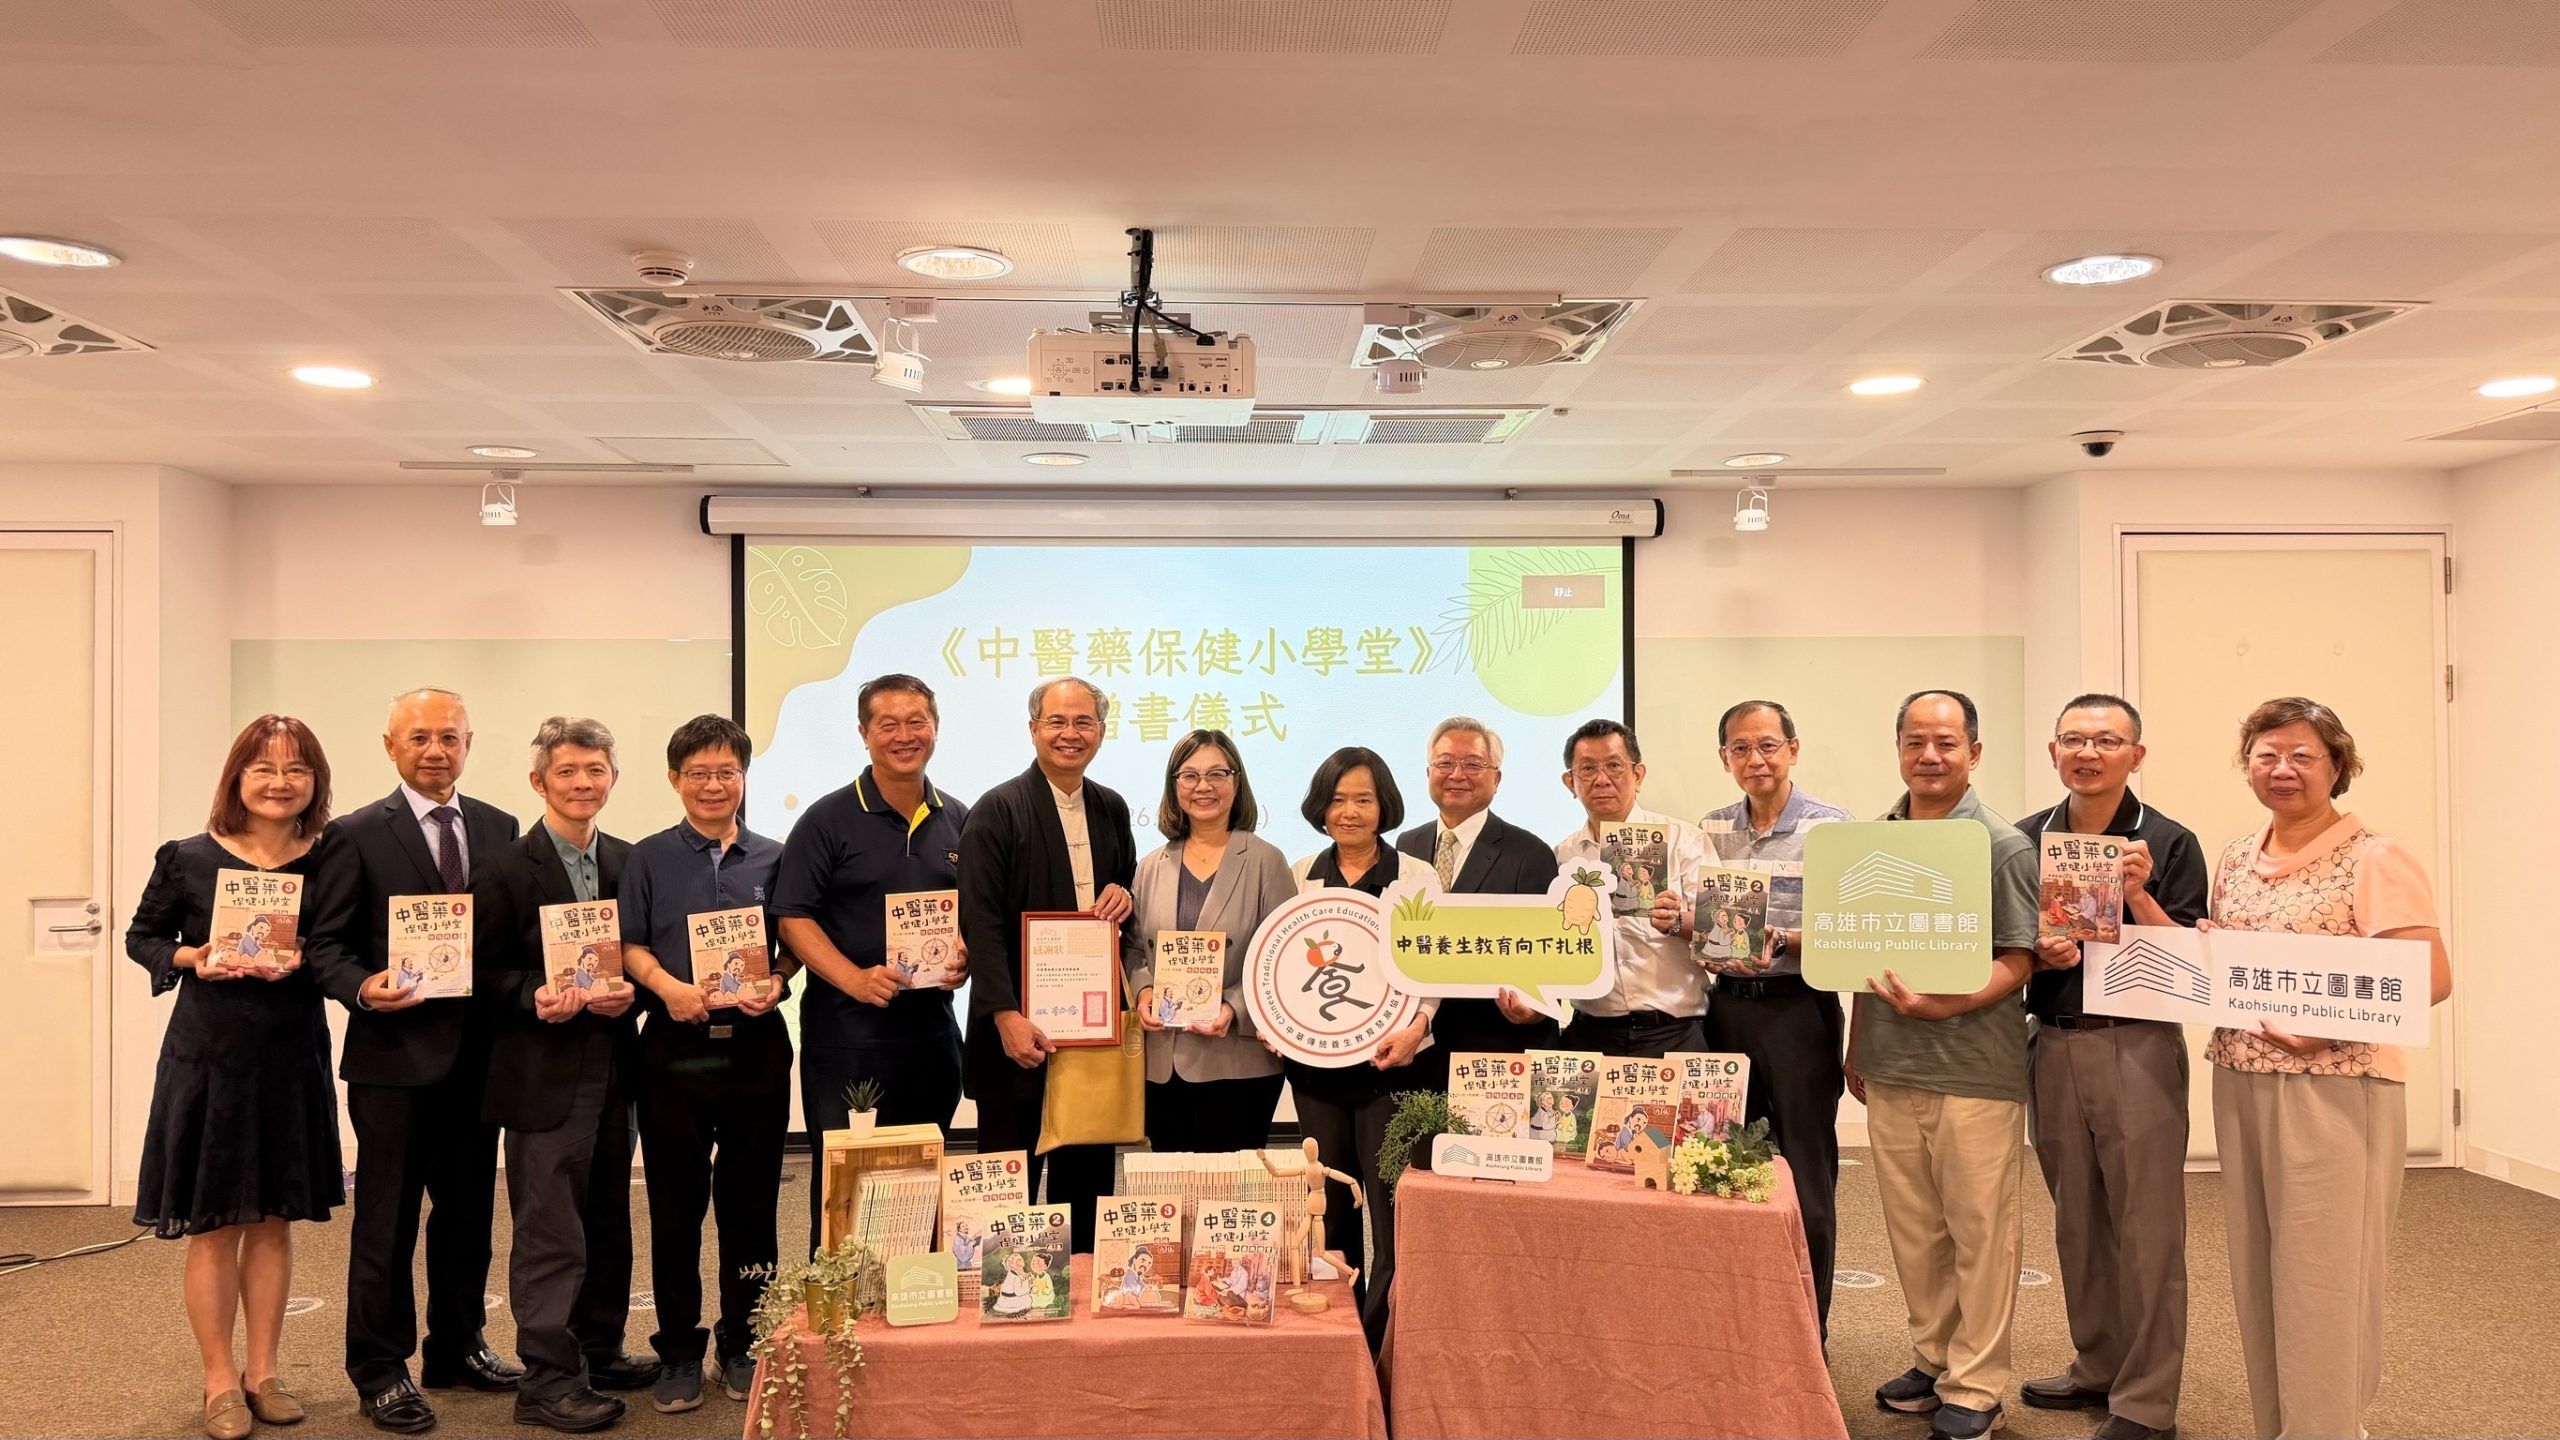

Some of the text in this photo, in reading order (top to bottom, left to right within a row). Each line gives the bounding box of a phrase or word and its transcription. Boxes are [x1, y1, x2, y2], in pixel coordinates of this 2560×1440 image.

[942, 626, 1434, 679] 《中醫藥保健小學堂》
[1606, 827, 1648, 845] 中醫藥
[2048, 840, 2100, 860] 中醫藥
[226, 876, 279, 895] 中醫藥
[1703, 874, 1748, 893] 中醫藥
[396, 901, 448, 922] 中醫藥
[549, 908, 597, 930] 中醫藥
[892, 899, 937, 919] 中醫藥
[1312, 907, 1334, 917] Care
[696, 915, 743, 938] 中醫藥
[1281, 912, 1311, 936] Health
[1813, 912, 1978, 934] 高雄市立圖書館
[1162, 936, 1205, 954] 中醫藥
[1396, 935, 1594, 956] 中醫養生教育向下扎根
[1814, 938, 1978, 953] Kaohsiung Public Library
[1262, 934, 1283, 987] Traditional
[2228, 965, 2403, 1002] 高雄市立圖書館
[1264, 988, 1286, 1026] Chinese
[2228, 998, 2402, 1026] Kaohsiung Public Library
[1286, 989, 1403, 1049] 中華傳統養生教育發展協
[1456, 1058, 1506, 1078] 中醫藥
[1531, 1056, 1578, 1074] 中醫藥
[1606, 1063, 1657, 1083] 中醫藥
[1686, 1058, 1720, 1076] 醫藥
[1486, 1153, 1543, 1165] 高雄市立圖書館
[950, 1160, 1002, 1184] 中醫藥
[991, 1212, 1045, 1235] 中醫藥
[1104, 1202, 1157, 1224] 中醫藥
[1204, 1208, 1257, 1229] 中醫藥
